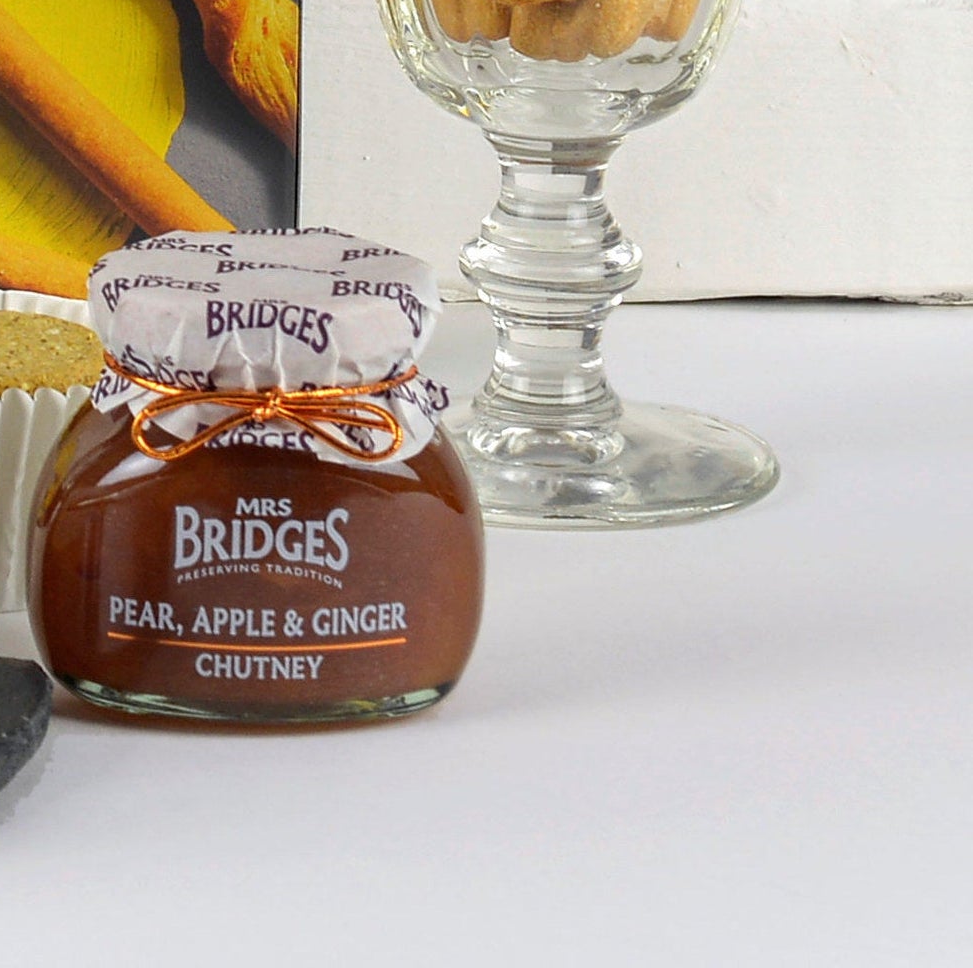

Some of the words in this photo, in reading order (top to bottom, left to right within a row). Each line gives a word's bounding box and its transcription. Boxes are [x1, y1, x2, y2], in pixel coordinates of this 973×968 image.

[206, 300, 333, 354] BRIDGES
[235, 497, 293, 518] MRS
[174, 506, 350, 573] BRIDGES
[177, 564, 260, 584] PRESERVING
[266, 564, 343, 590] TRADITION
[109, 596, 184, 637] PEAR,
[192, 606, 276, 637] APPLE
[283, 610, 304, 637] &
[312, 602, 407, 637] GINGER
[195, 653, 324, 680] CHUTNEY
